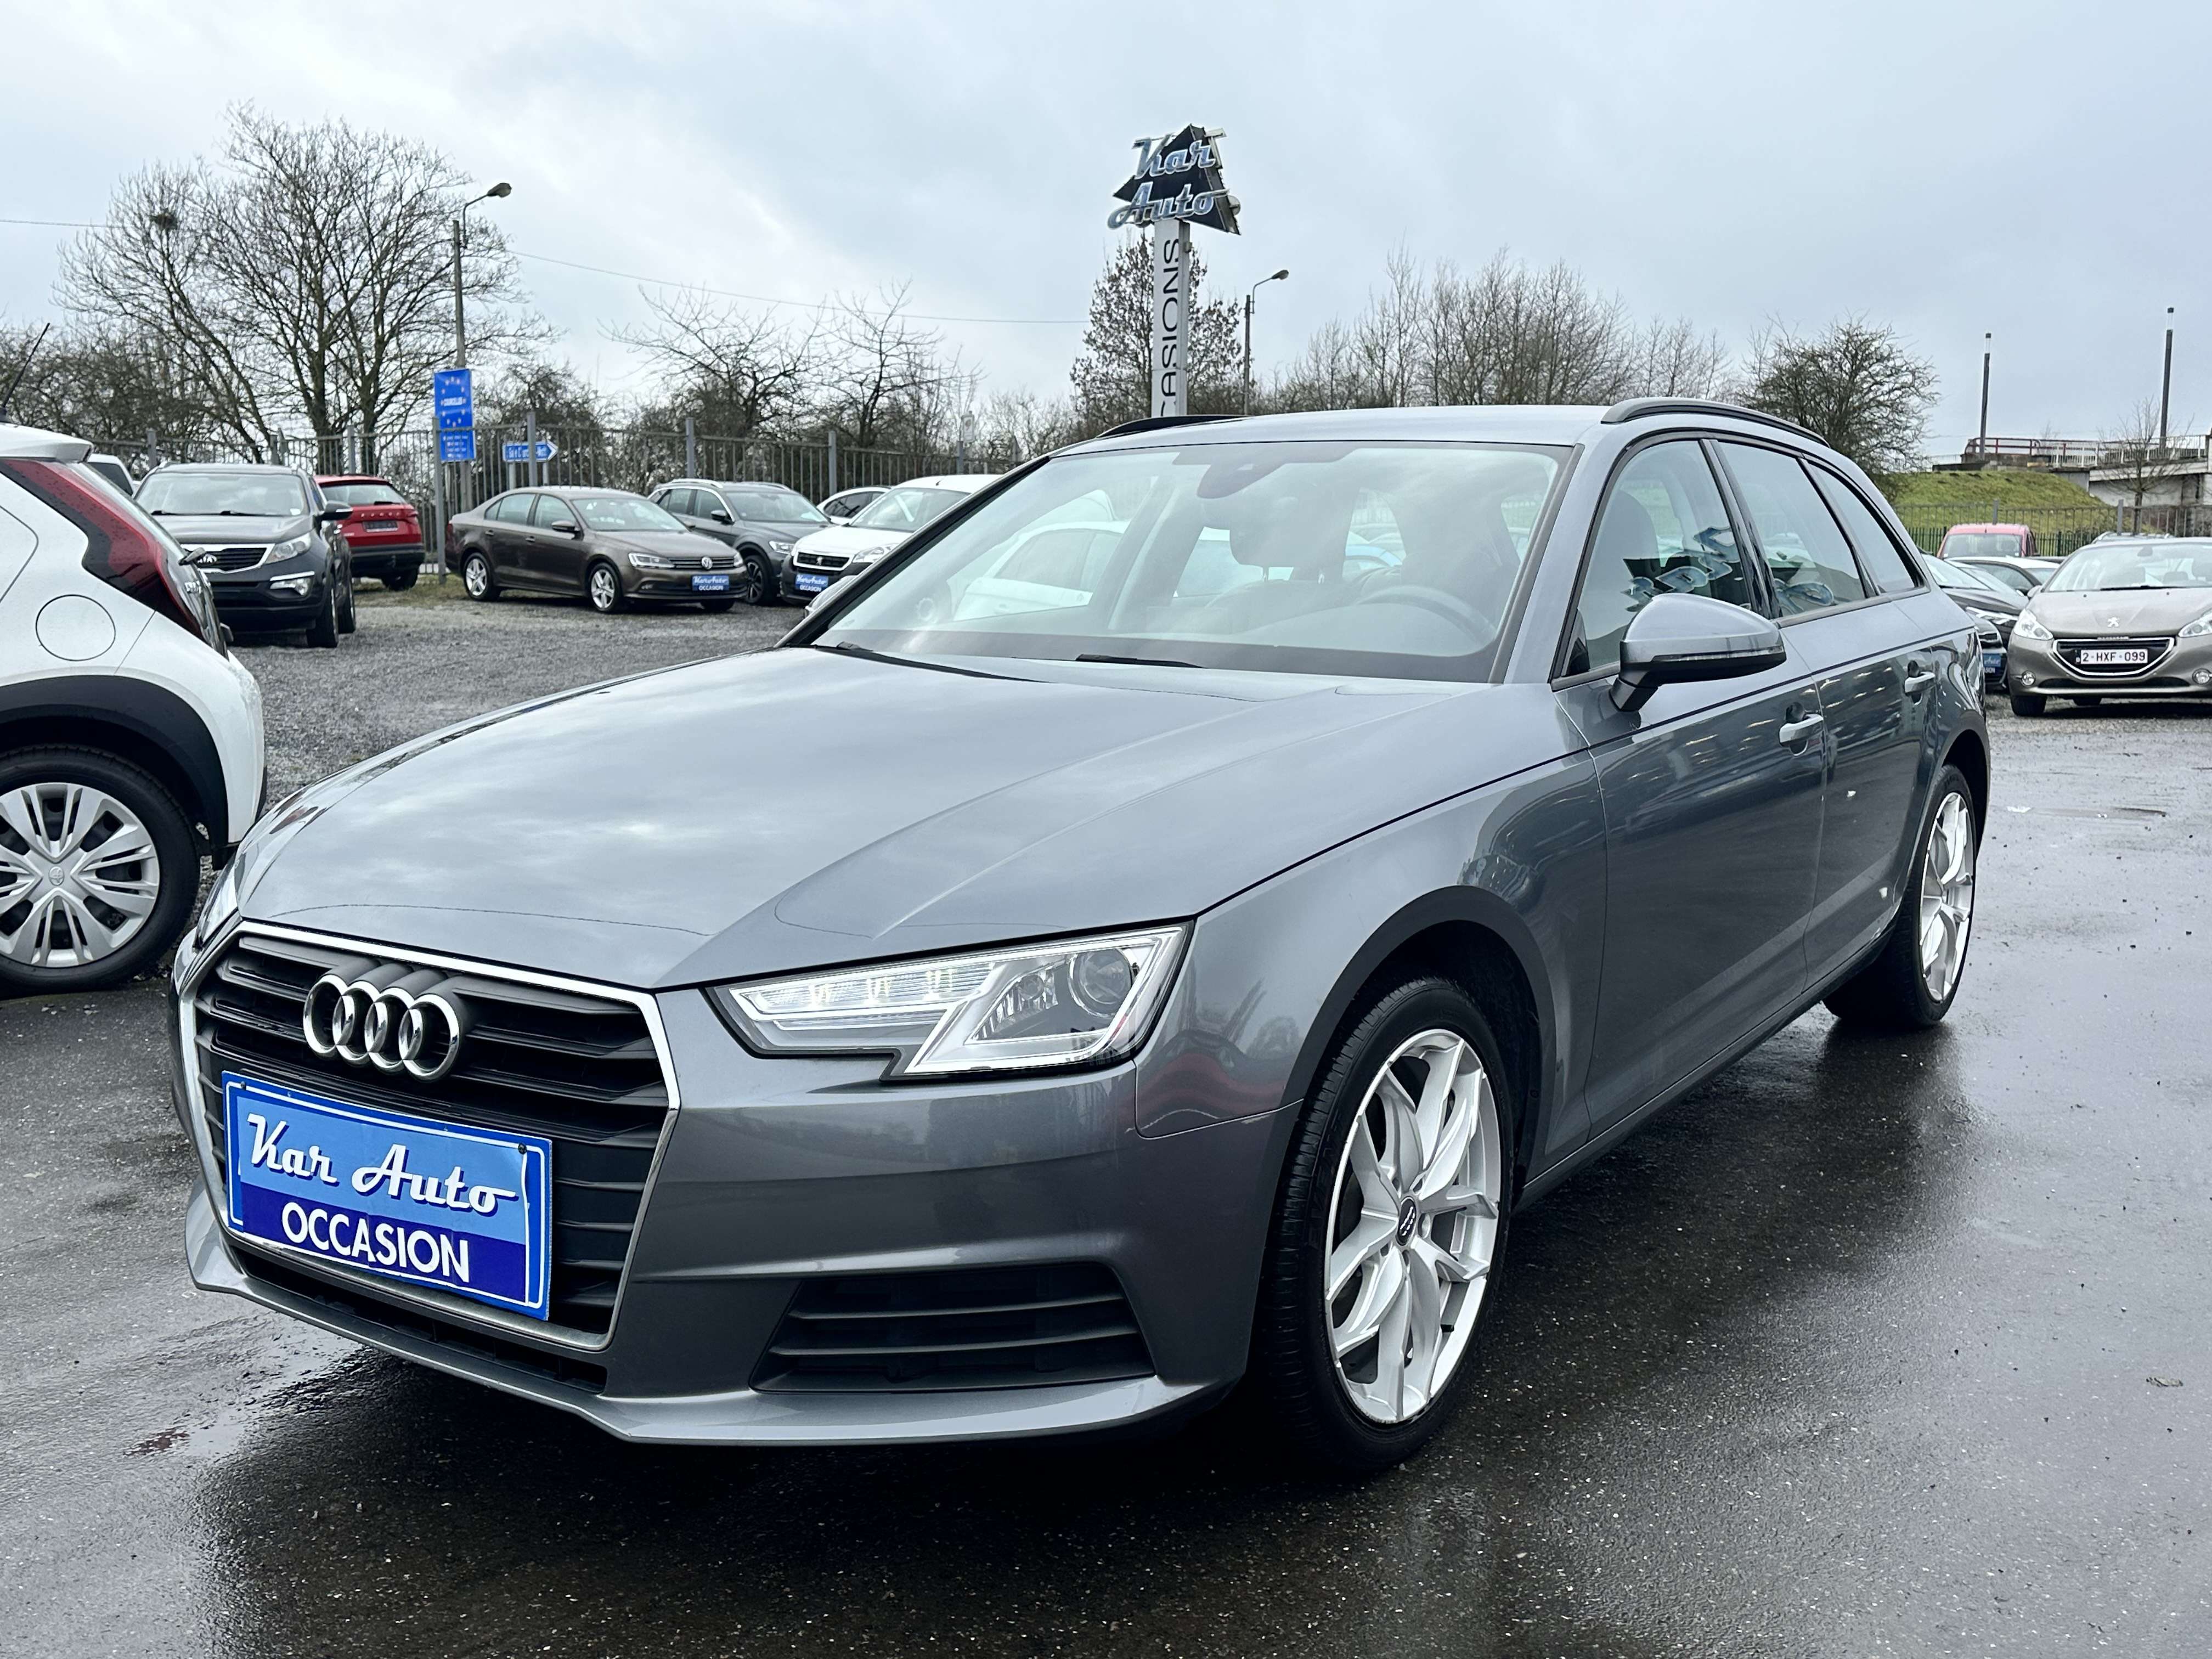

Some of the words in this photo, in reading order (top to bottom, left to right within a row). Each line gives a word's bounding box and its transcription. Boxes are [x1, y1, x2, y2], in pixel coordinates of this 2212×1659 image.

[1131, 132, 1216, 180] Kar
[1107, 181, 1229, 230] Auto
[247, 1113, 339, 1185] Kar
[351, 1143, 518, 1215] Auto
[281, 1202, 470, 1283] OCCASION
